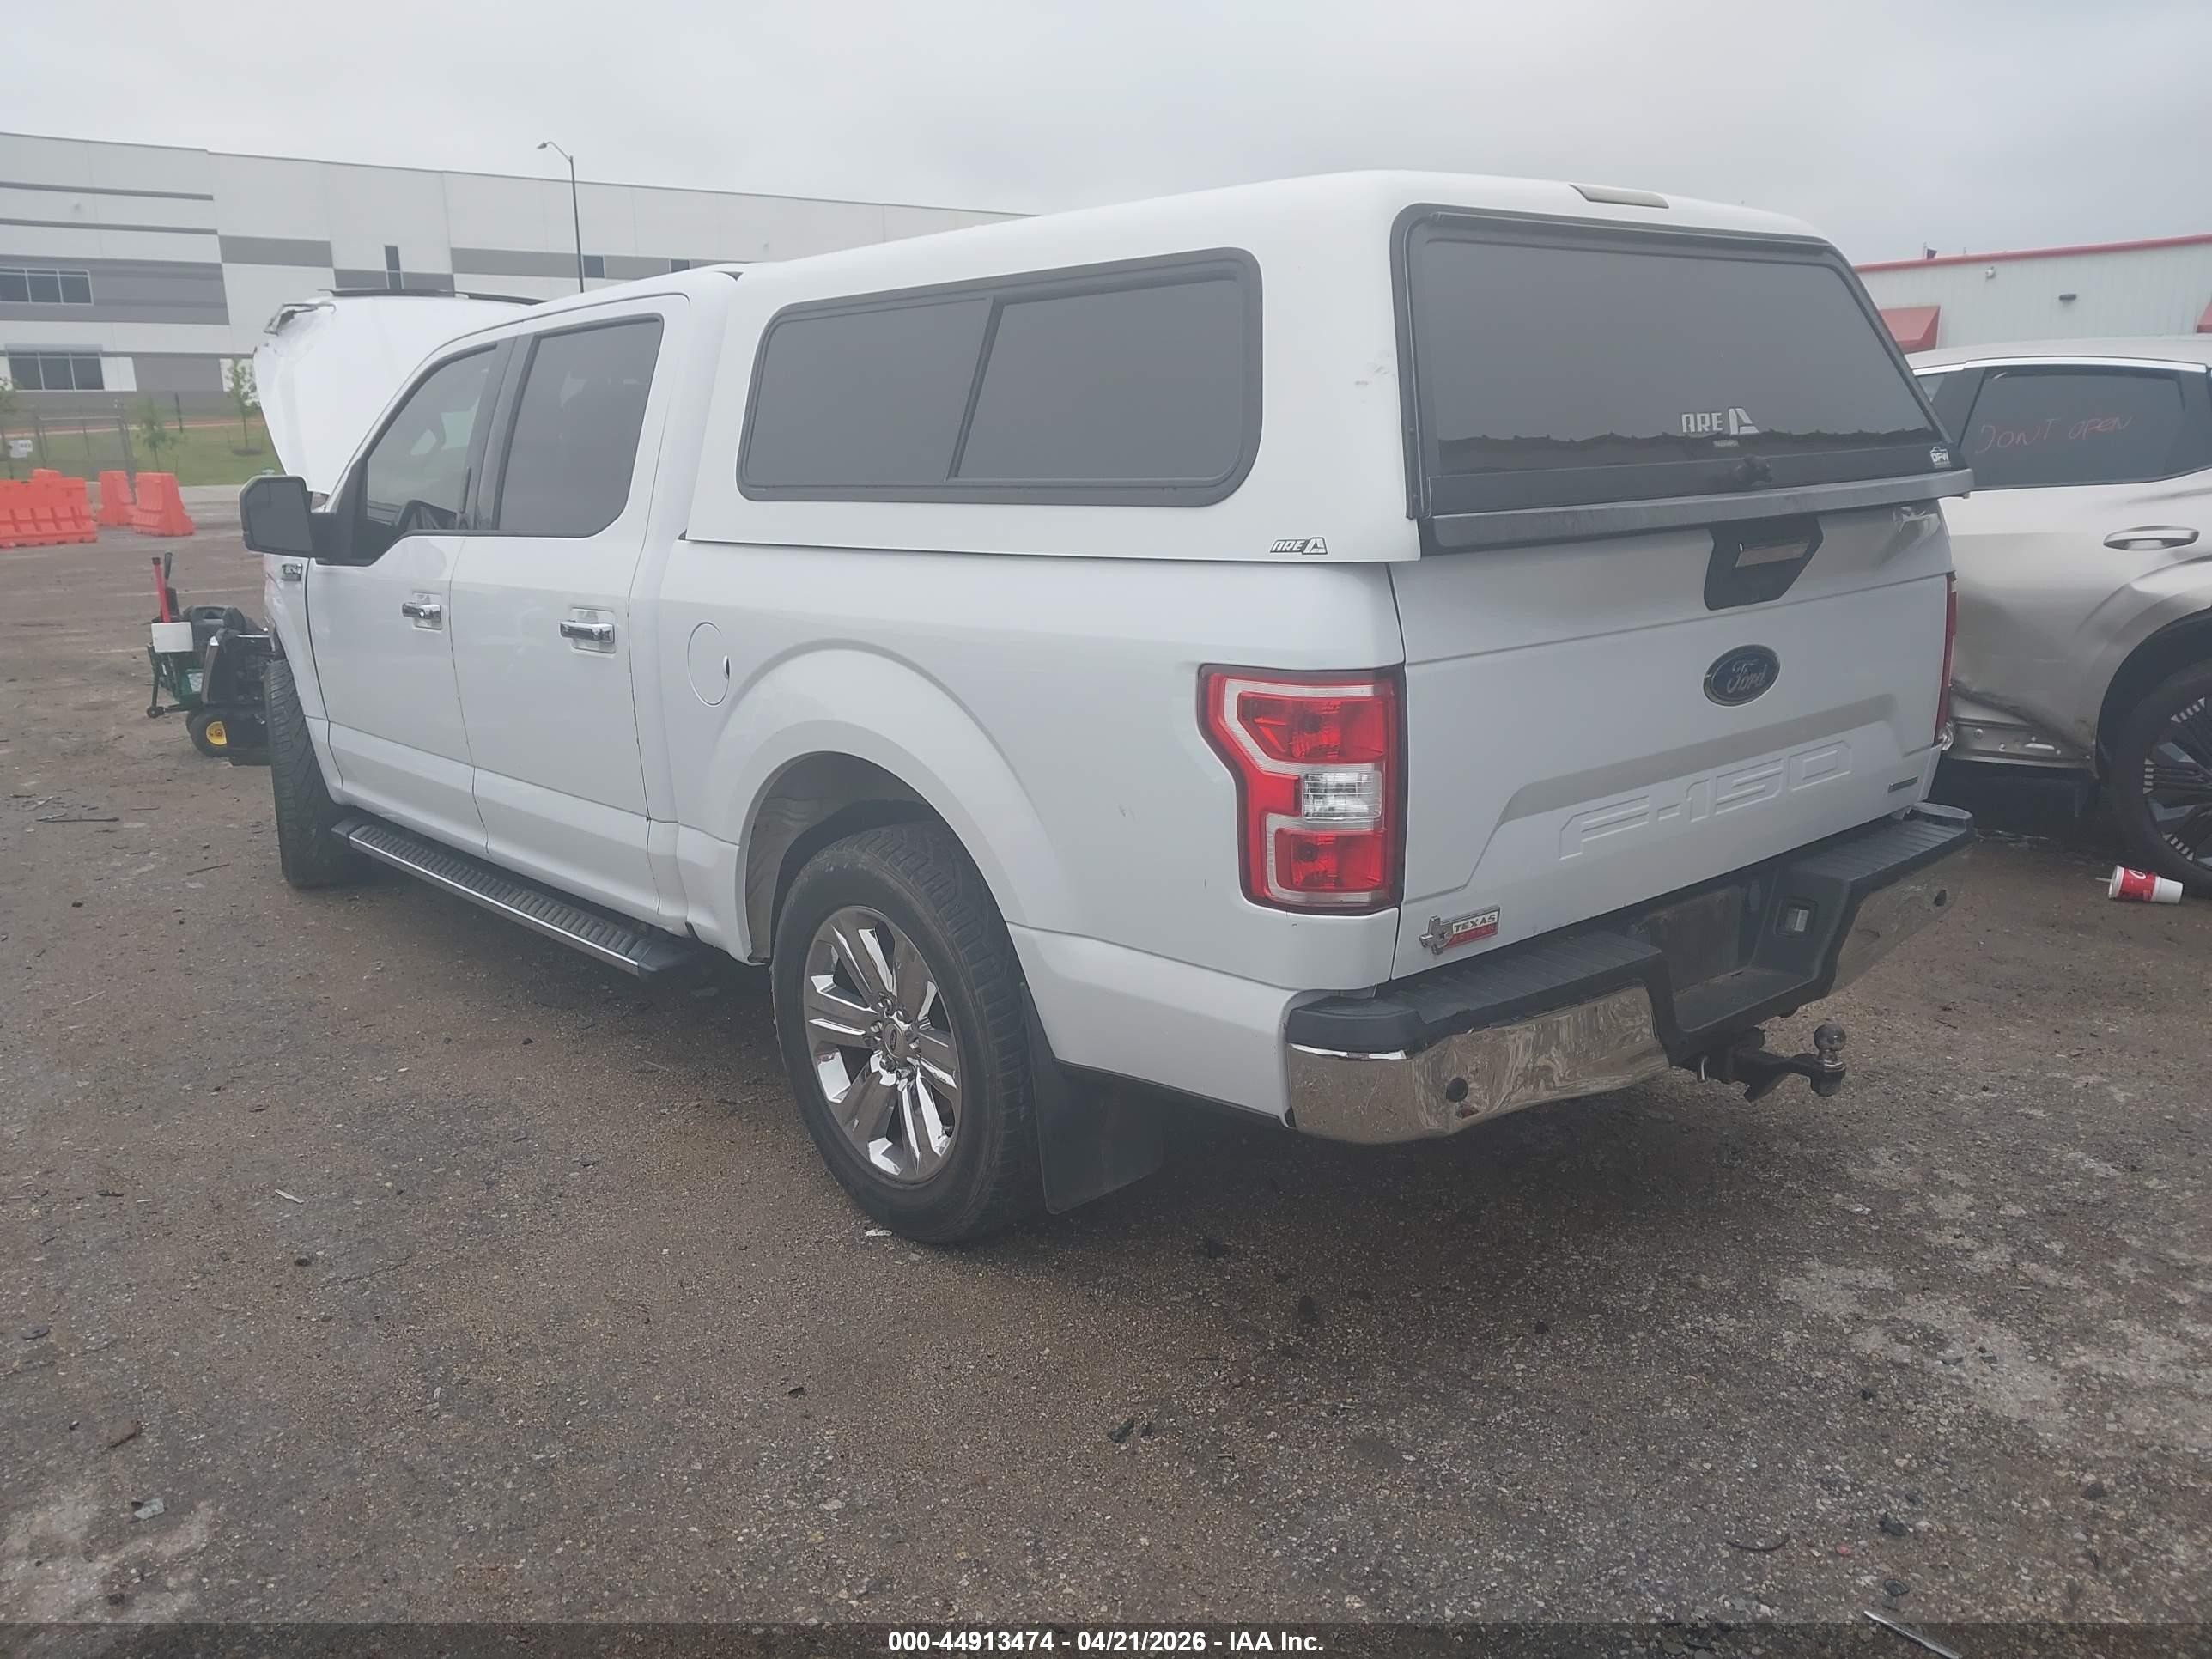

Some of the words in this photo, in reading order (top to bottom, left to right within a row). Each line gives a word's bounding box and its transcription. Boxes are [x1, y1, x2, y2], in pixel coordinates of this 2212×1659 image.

[2068, 416, 2132, 440] OPEN
[1727, 659, 1768, 694] Ford
[1559, 740, 1851, 860] F-150
[1454, 913, 1497, 933] TEXAS
